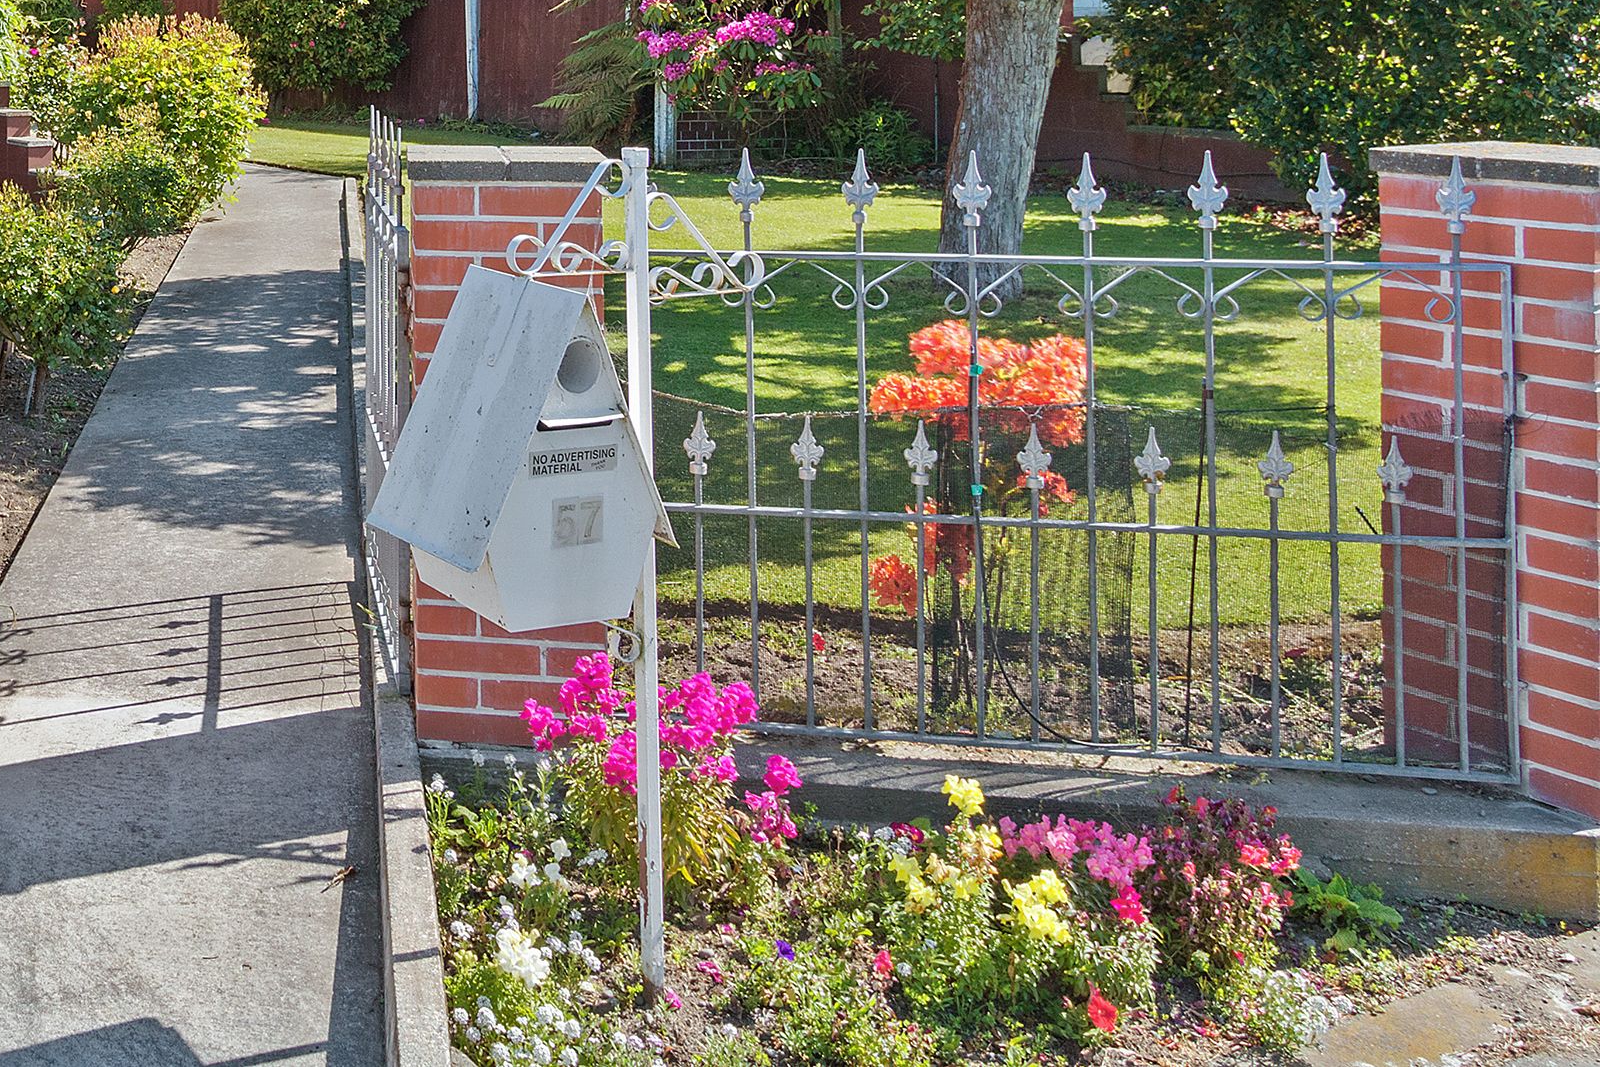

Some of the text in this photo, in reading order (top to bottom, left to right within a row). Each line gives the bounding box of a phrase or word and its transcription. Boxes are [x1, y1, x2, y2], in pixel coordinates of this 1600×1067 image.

[532, 447, 615, 465] NO ADVERTISING
[532, 462, 582, 475] MATERIAL
[555, 501, 601, 541] 57
